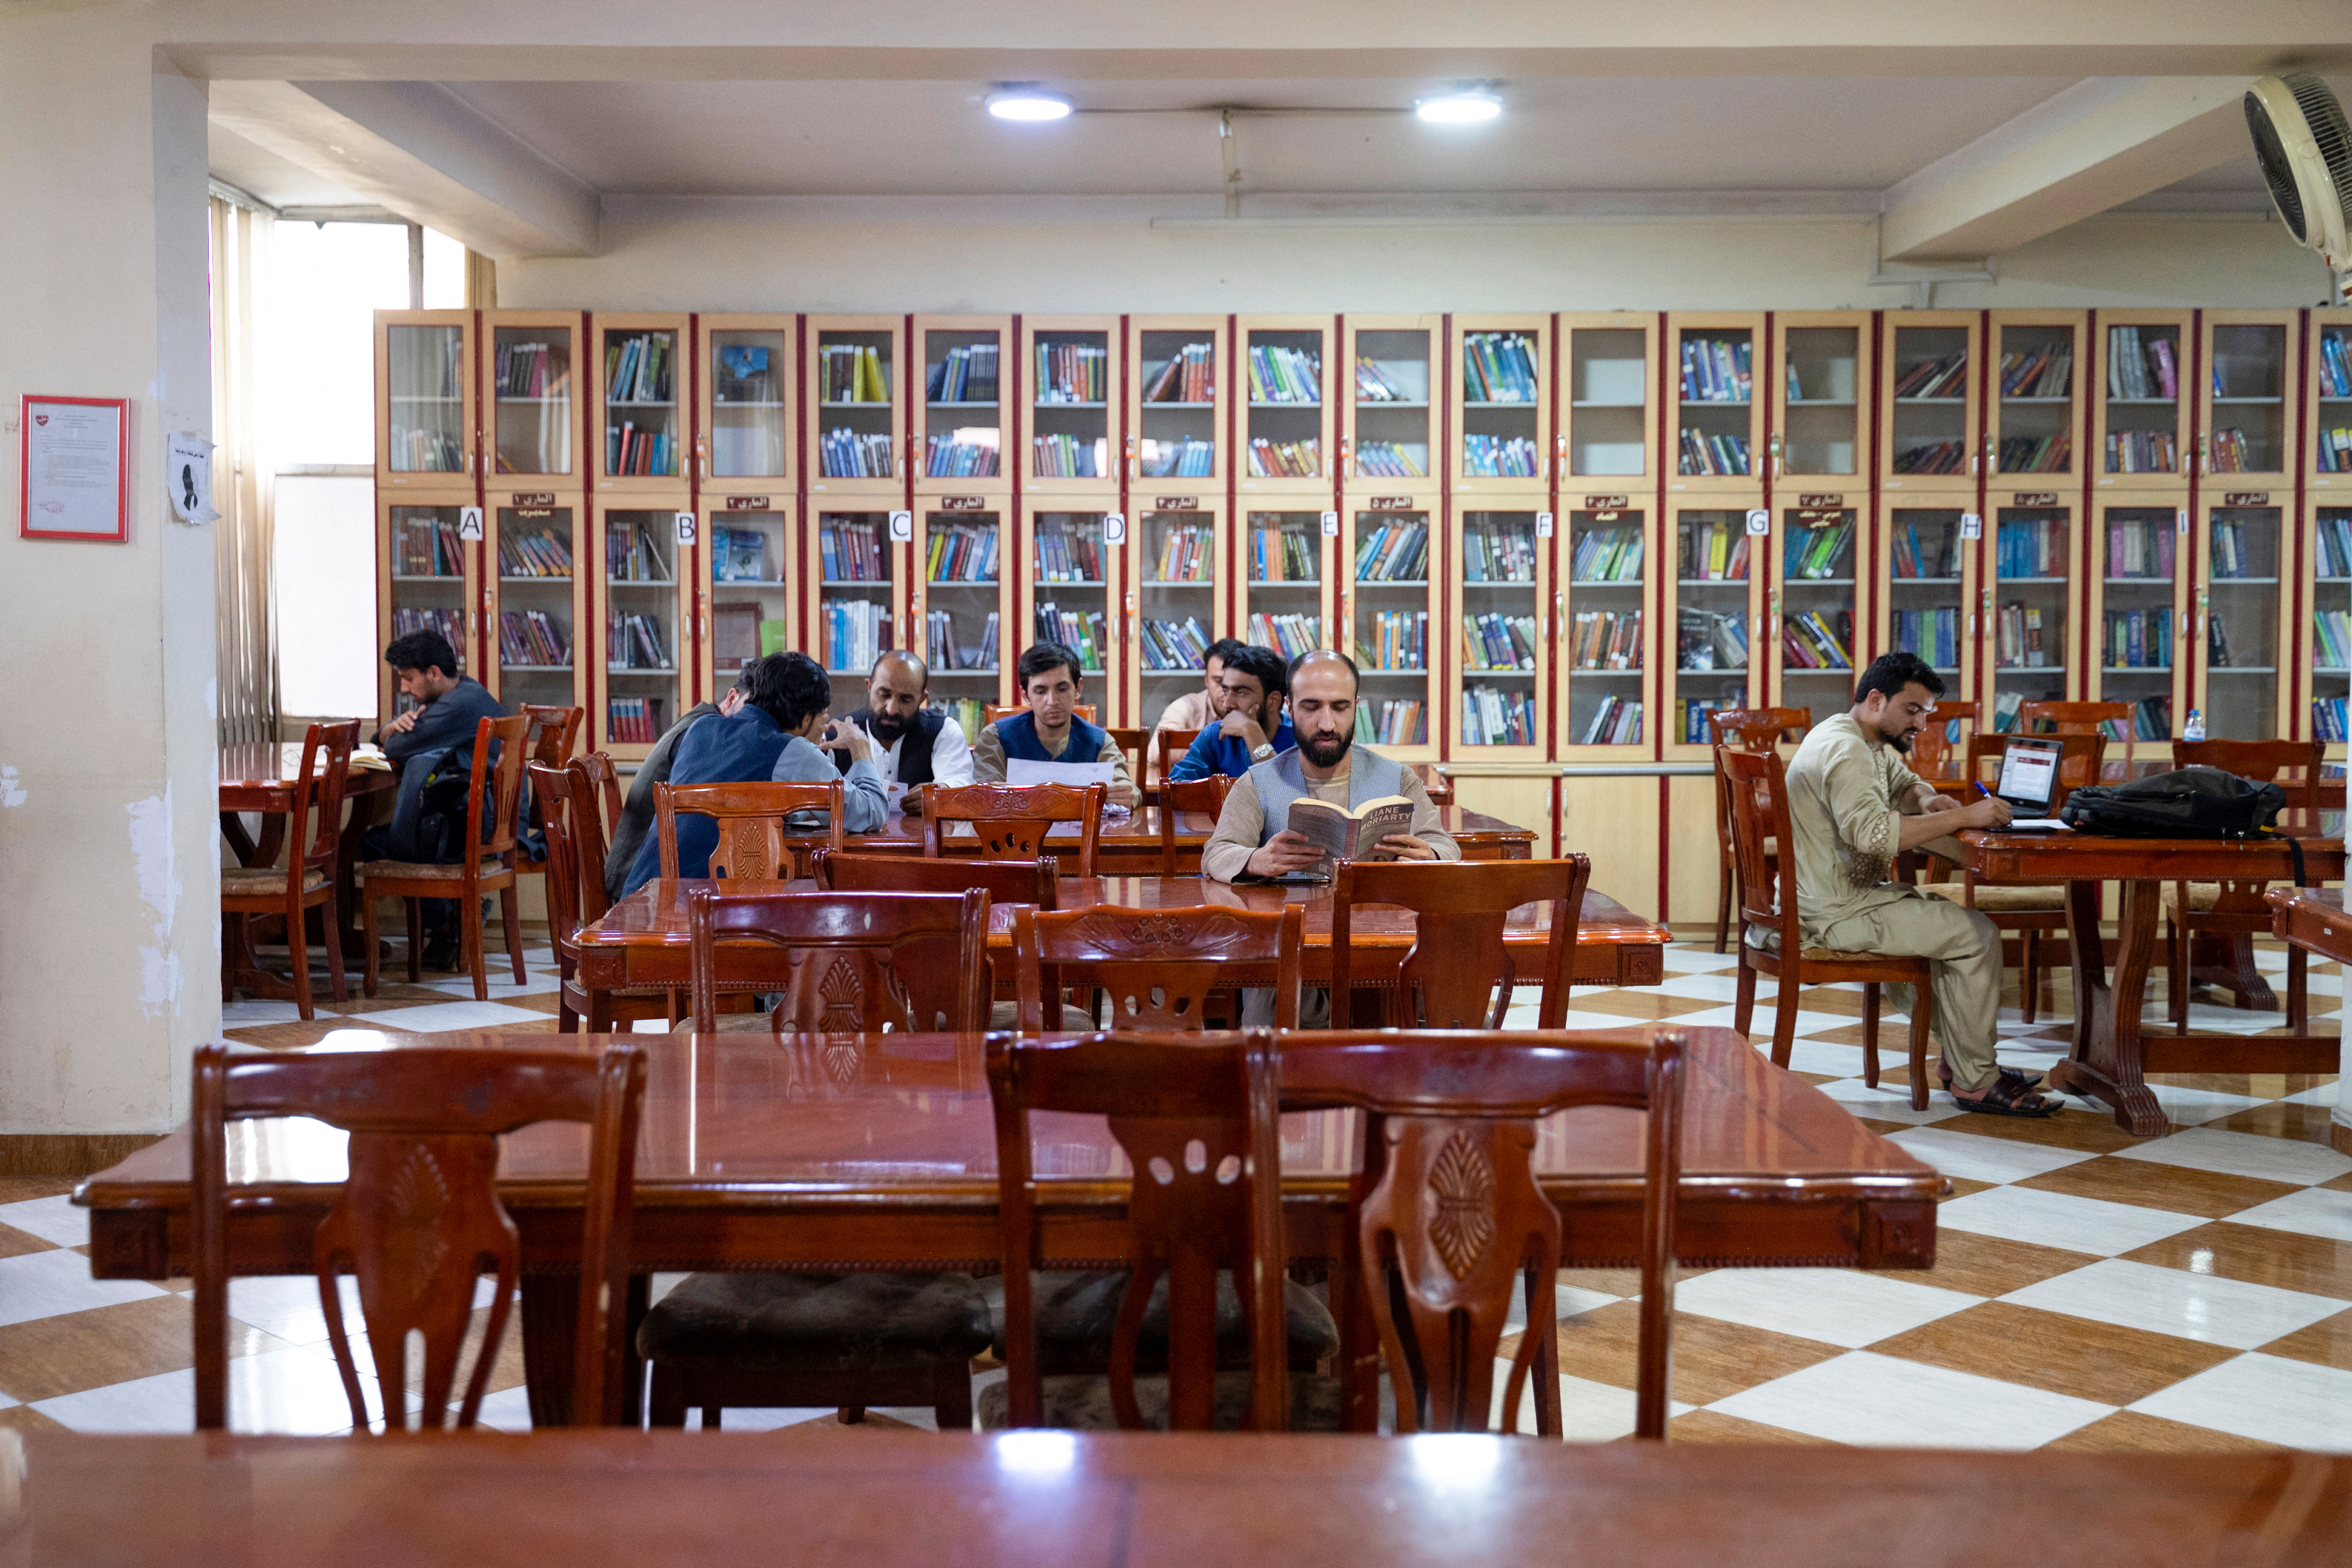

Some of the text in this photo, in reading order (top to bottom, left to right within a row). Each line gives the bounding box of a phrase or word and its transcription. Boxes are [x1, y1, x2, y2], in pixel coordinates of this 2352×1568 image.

[462, 511, 480, 534] A
[679, 517, 694, 539] B
[893, 513, 909, 536] C
[1107, 518, 1123, 540] D
[1324, 513, 1334, 534] E
[1539, 515, 1549, 534] F
[1750, 511, 1766, 532] G
[1964, 517, 1979, 536] H
[2181, 513, 2186, 532] I
[1361, 812, 1411, 831] MORIARTY
[1370, 806, 1400, 819] LIANE
